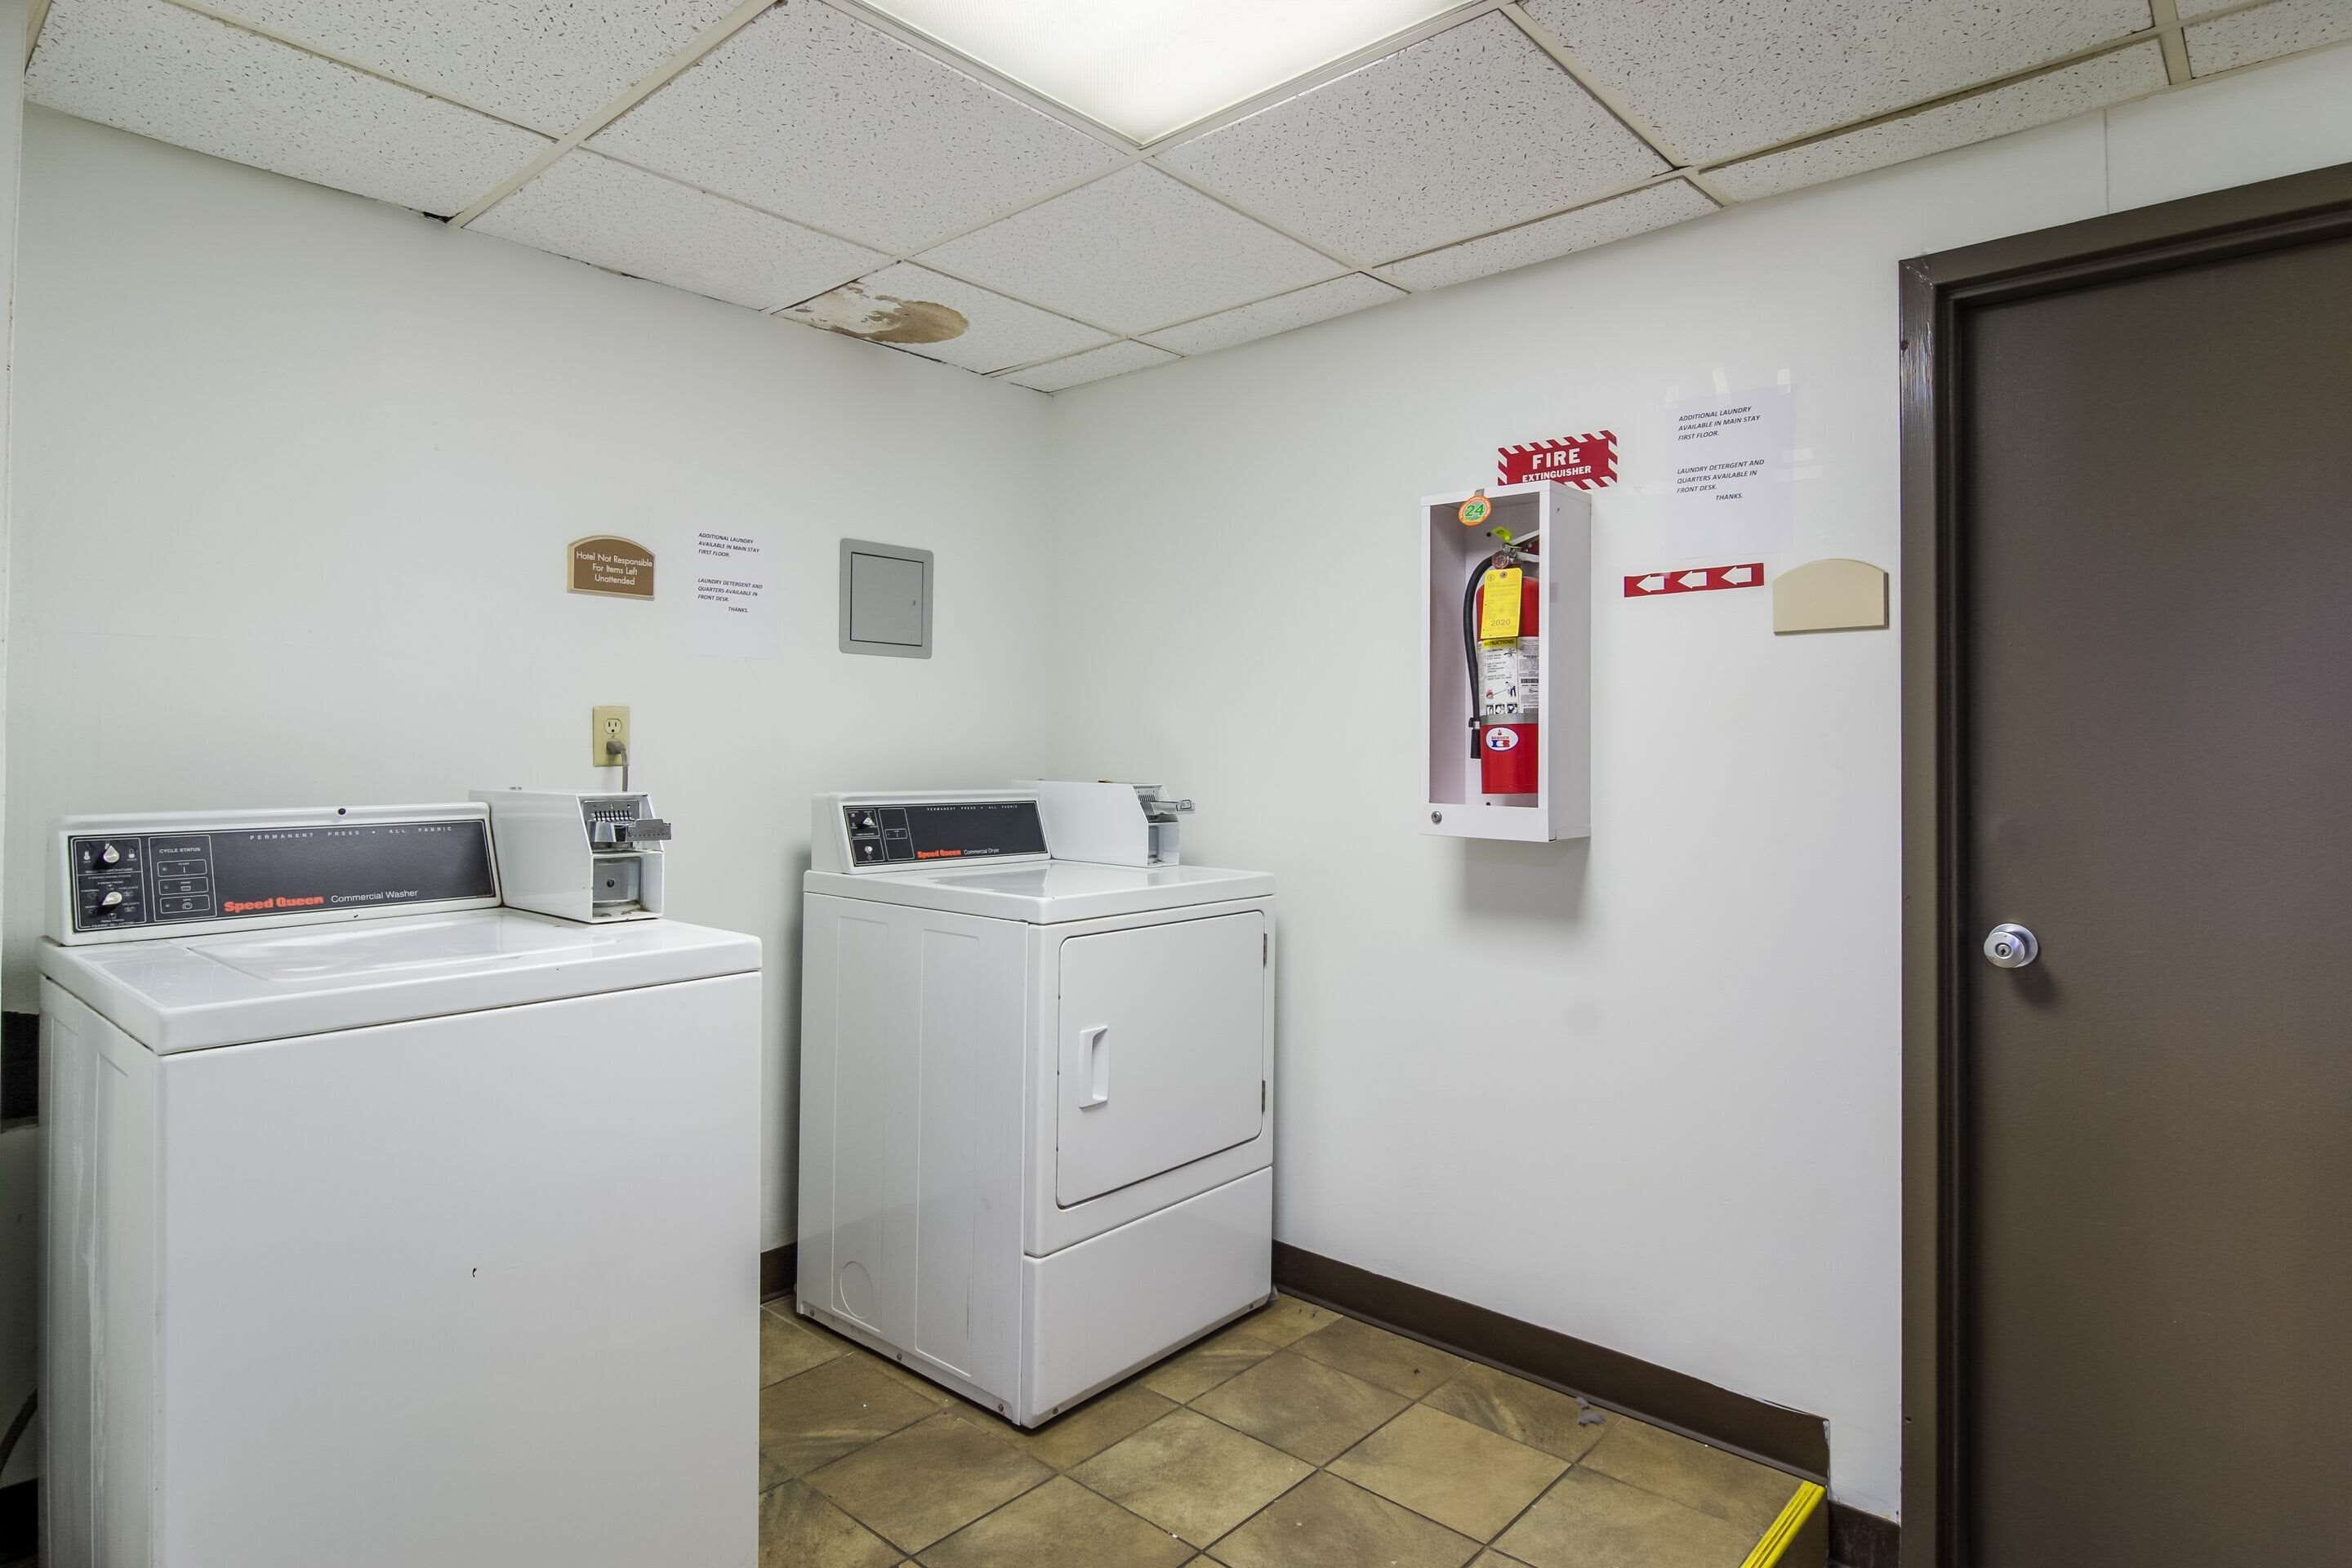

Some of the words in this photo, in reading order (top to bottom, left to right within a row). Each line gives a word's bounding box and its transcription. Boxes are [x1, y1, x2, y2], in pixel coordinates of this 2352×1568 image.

[1679, 412, 1717, 421] ADDITIONAL
[1720, 407, 1752, 416] LAUNDRY
[1678, 421, 1713, 431] AVAILABLE
[1744, 415, 1761, 423] STAY
[1696, 430, 1718, 439] FLOOR.
[1532, 448, 1580, 470] FIRE
[1709, 461, 1748, 470] DETERGENT
[1522, 466, 1591, 483] EXTINGUISHER
[1677, 475, 1711, 483] QUARTERS
[1712, 470, 1748, 480] AVAILABLE
[1465, 503, 1485, 516] 24
[699, 532, 728, 541] ADDITIONAL
[699, 541, 725, 549] AVAILABLE
[577, 551, 595, 560] Hotel
[598, 554, 612, 562] Not
[614, 555, 653, 567] Responsible
[593, 563, 604, 572] For
[606, 565, 623, 573] Items
[626, 567, 637, 575] Left
[595, 574, 635, 585] Unattended
[917, 850, 939, 859] Speed
[224, 898, 274, 913] Speed
[276, 896, 324, 909] Queen
[332, 891, 384, 903] Commercial
[385, 889, 418, 899] Washer
